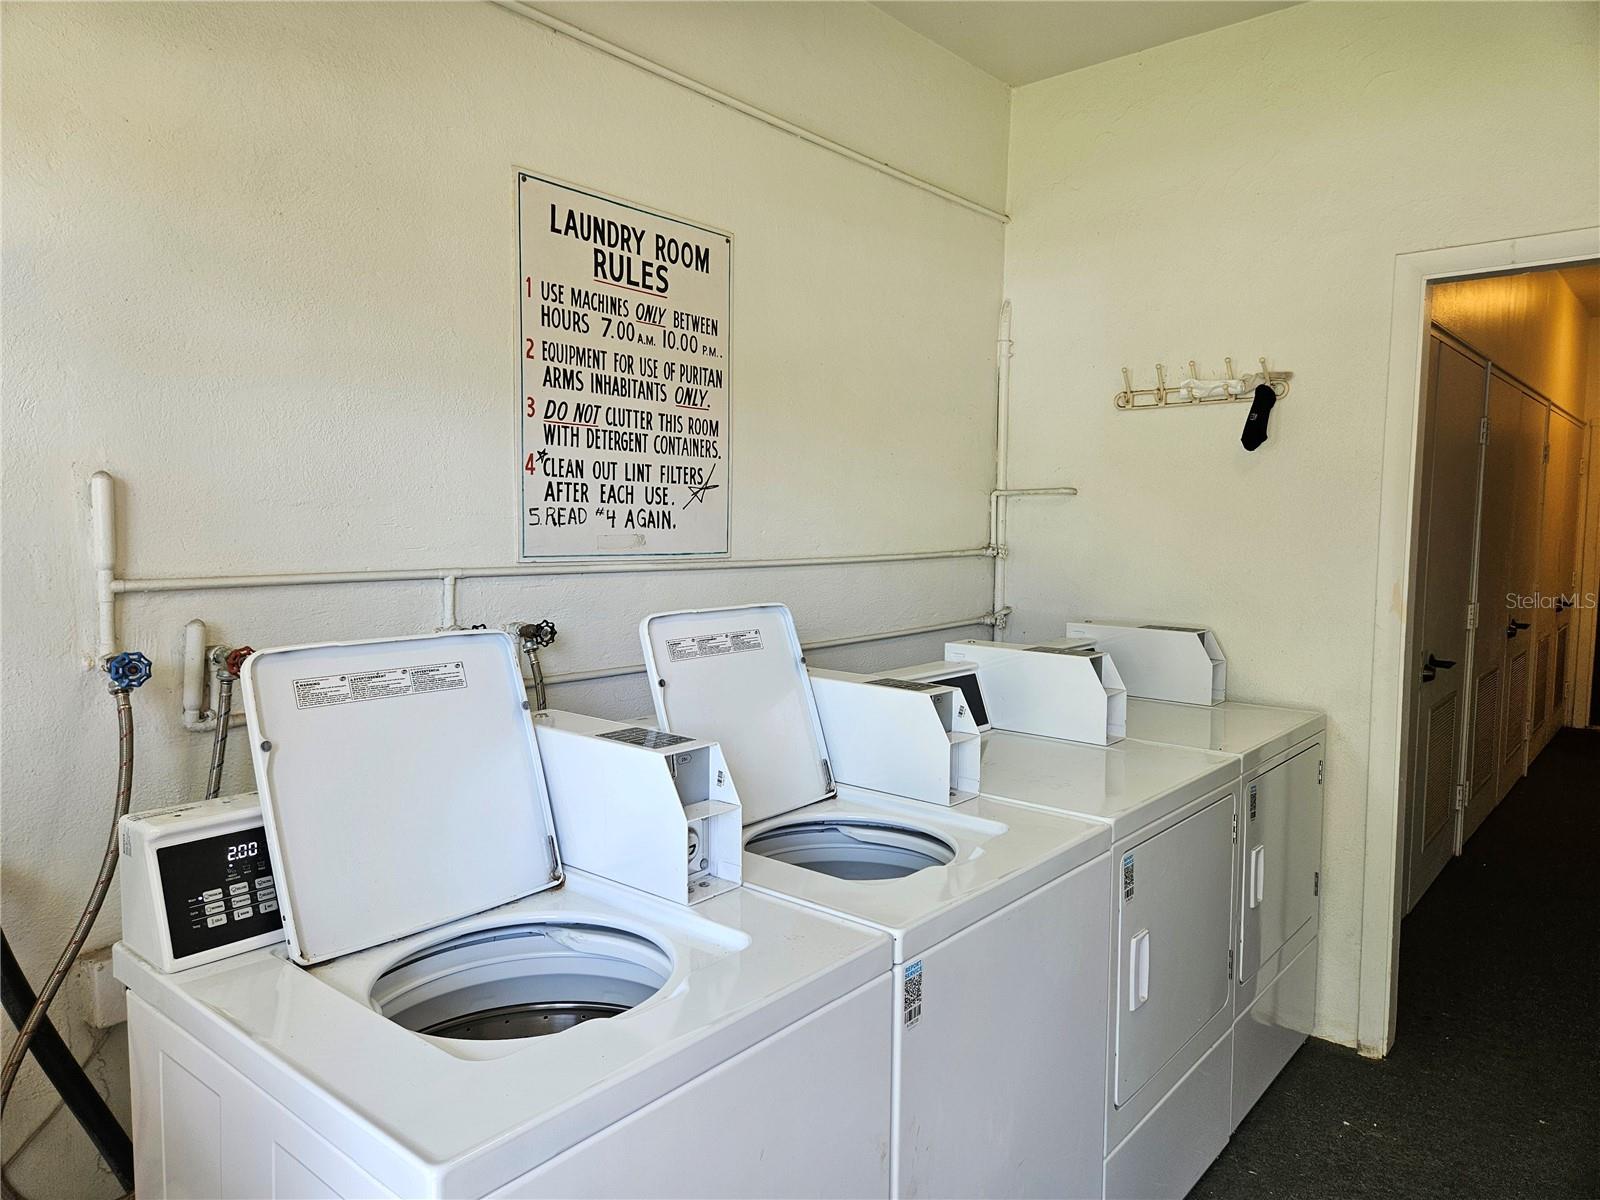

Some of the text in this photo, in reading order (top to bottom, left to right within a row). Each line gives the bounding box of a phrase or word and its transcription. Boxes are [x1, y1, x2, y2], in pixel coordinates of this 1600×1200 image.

[550, 203, 710, 274] LAUNDRY ROOM
[593, 247, 669, 293] RULES
[525, 276, 718, 337] 1 USE MACHINES ONLY BETWEEN
[541, 304, 590, 334] HOURS
[601, 316, 635, 342] 7.00
[637, 333, 656, 346] A.M.
[663, 329, 698, 354] 10.00
[526, 338, 723, 389] 2 EQUIPMENT FOR USE OF PURITAN
[542, 365, 711, 408] ARMS INHABITANTS ONLY.
[526, 396, 719, 438] 3 DO NOT CLUTTER THIS ROOM
[543, 423, 722, 460] WITH DETERGENT CONTAINERS.
[525, 453, 704, 486] 4 CLEAN OUT LINT FILTERS
[543, 481, 675, 506] AFTER EACH USE.
[624, 508, 677, 530] AGAIN.
[227, 841, 258, 861] 2.00
